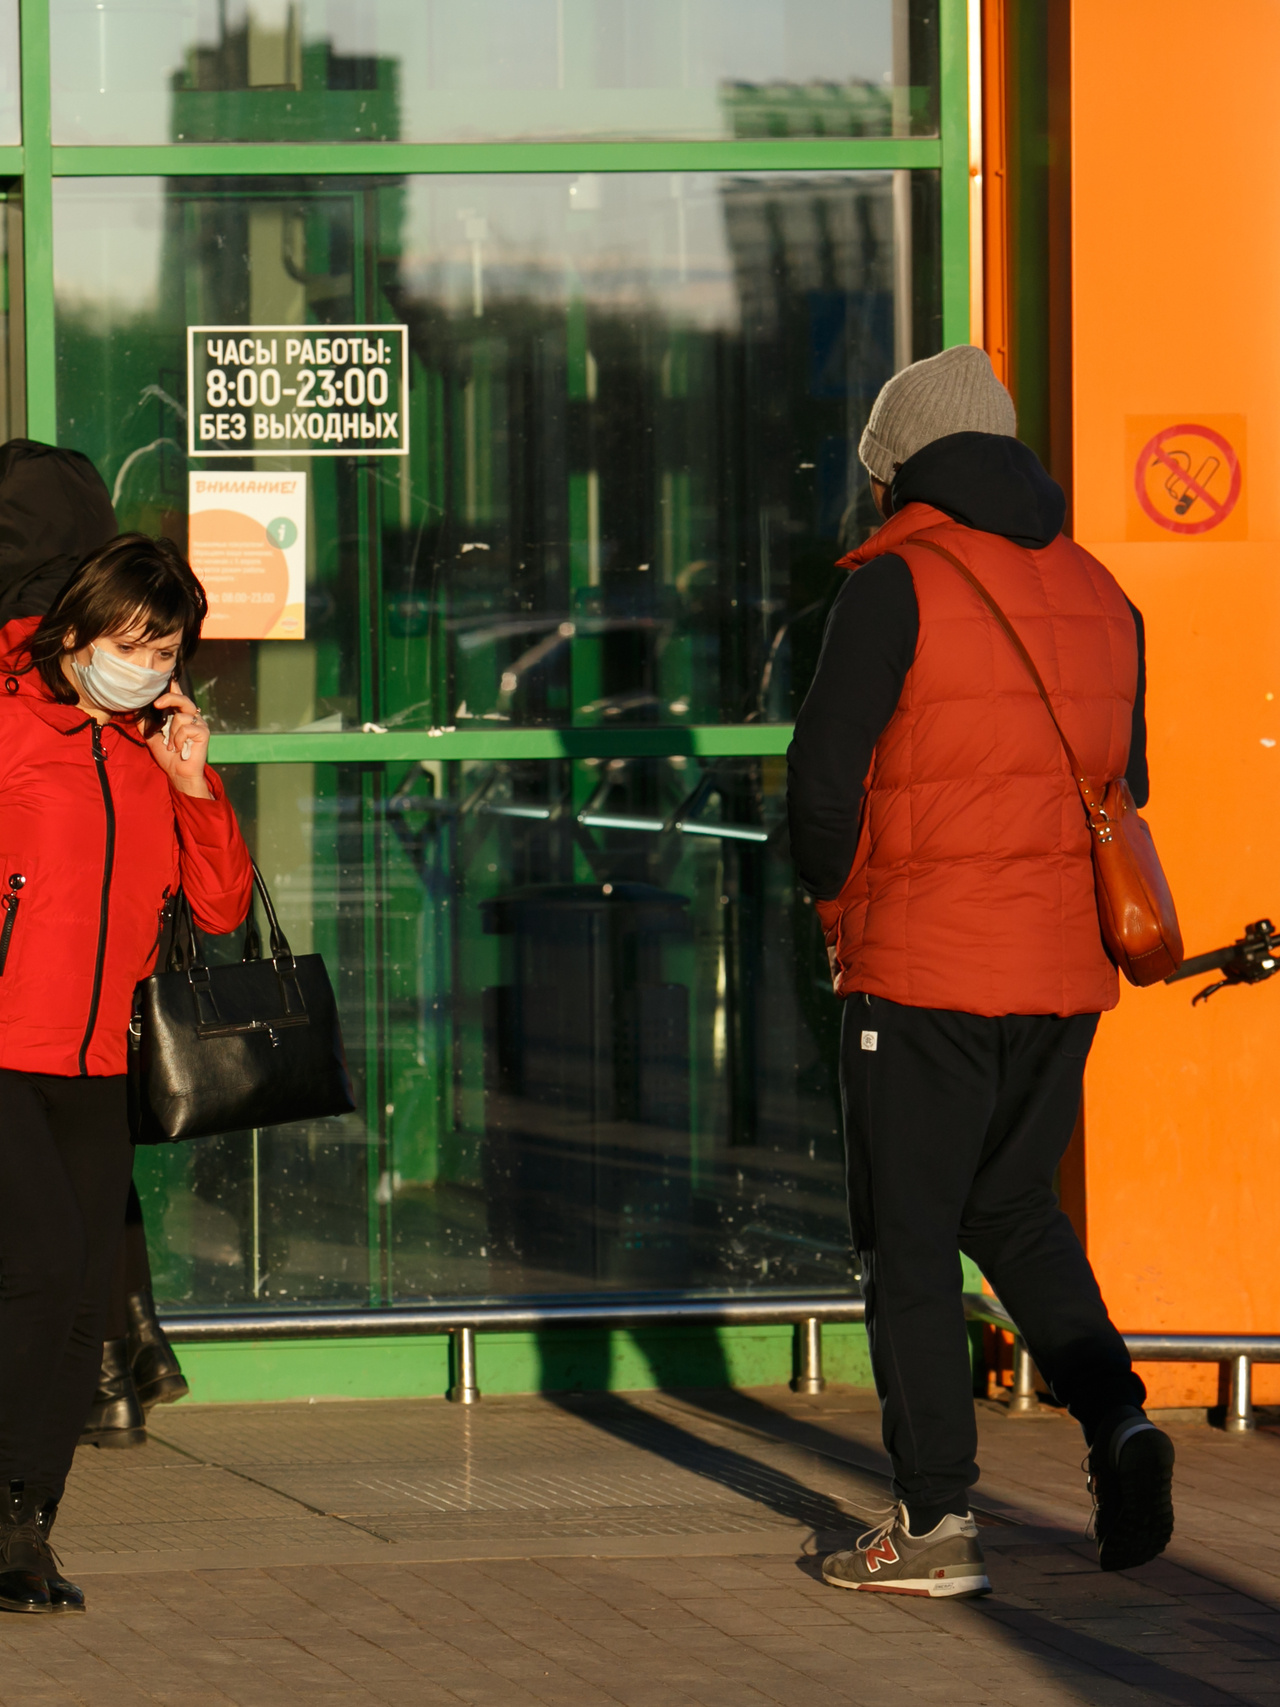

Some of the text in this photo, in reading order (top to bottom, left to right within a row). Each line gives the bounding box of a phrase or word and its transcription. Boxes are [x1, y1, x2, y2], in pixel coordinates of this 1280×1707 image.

[207, 338, 392, 365] ЧАСЫ РАБОТЫ:
[206, 368, 388, 408] 8:00-23:00
[200, 412, 399, 442] БЕЗ ВЫХОДНЫХ
[195, 481, 297, 495] ВНИМАНИЕ!
[865, 1536, 900, 1573] N
